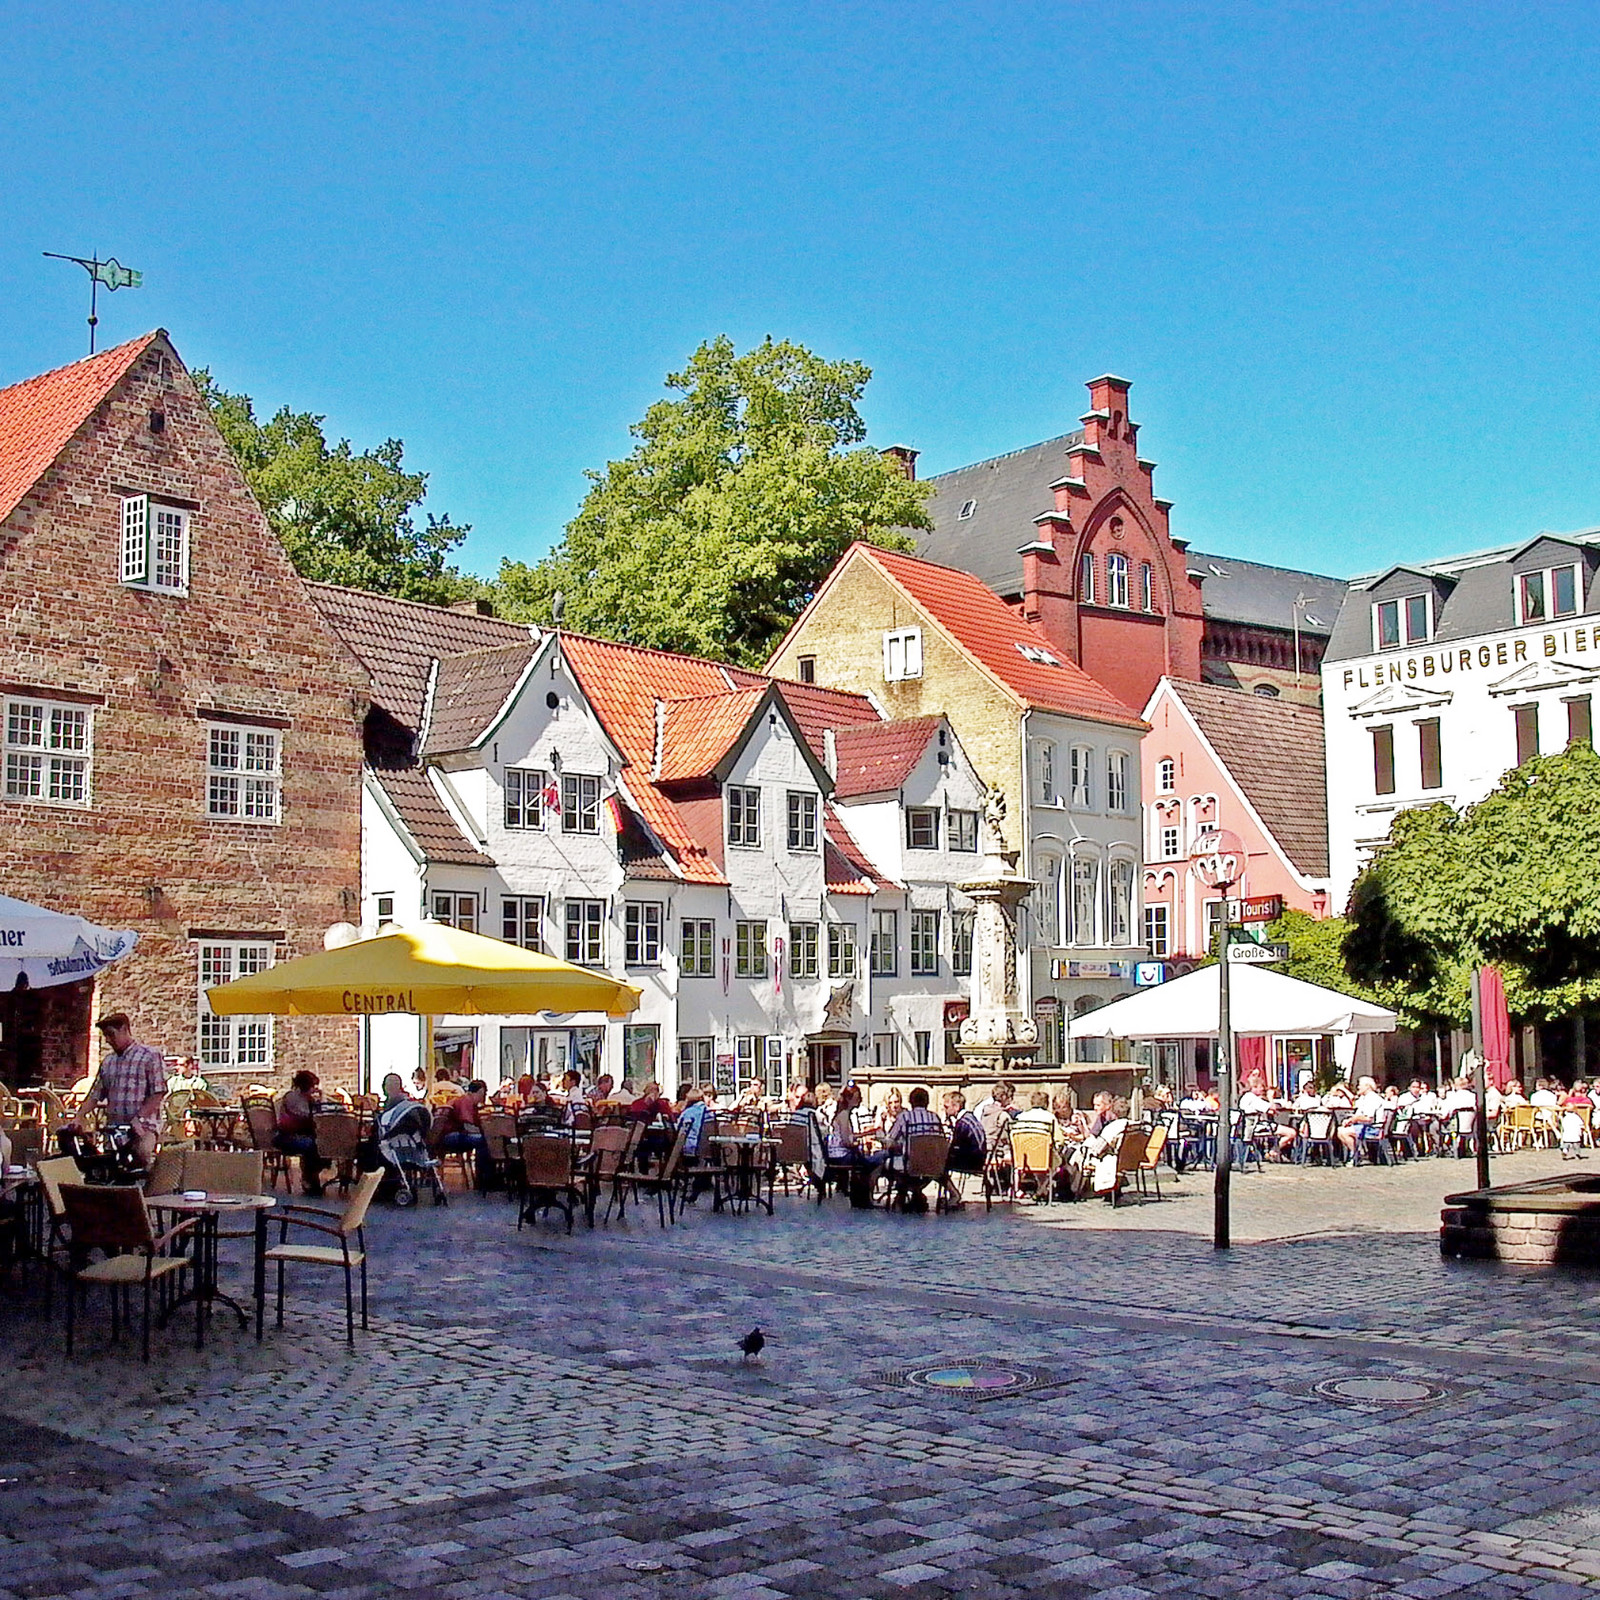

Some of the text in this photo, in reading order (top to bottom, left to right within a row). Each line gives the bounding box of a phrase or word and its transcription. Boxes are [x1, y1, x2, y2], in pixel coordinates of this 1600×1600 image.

[1343, 640, 1528, 690] FLENSBURGER
[1232, 947, 1265, 959] Große
[342, 989, 417, 1012] CENTRAL
